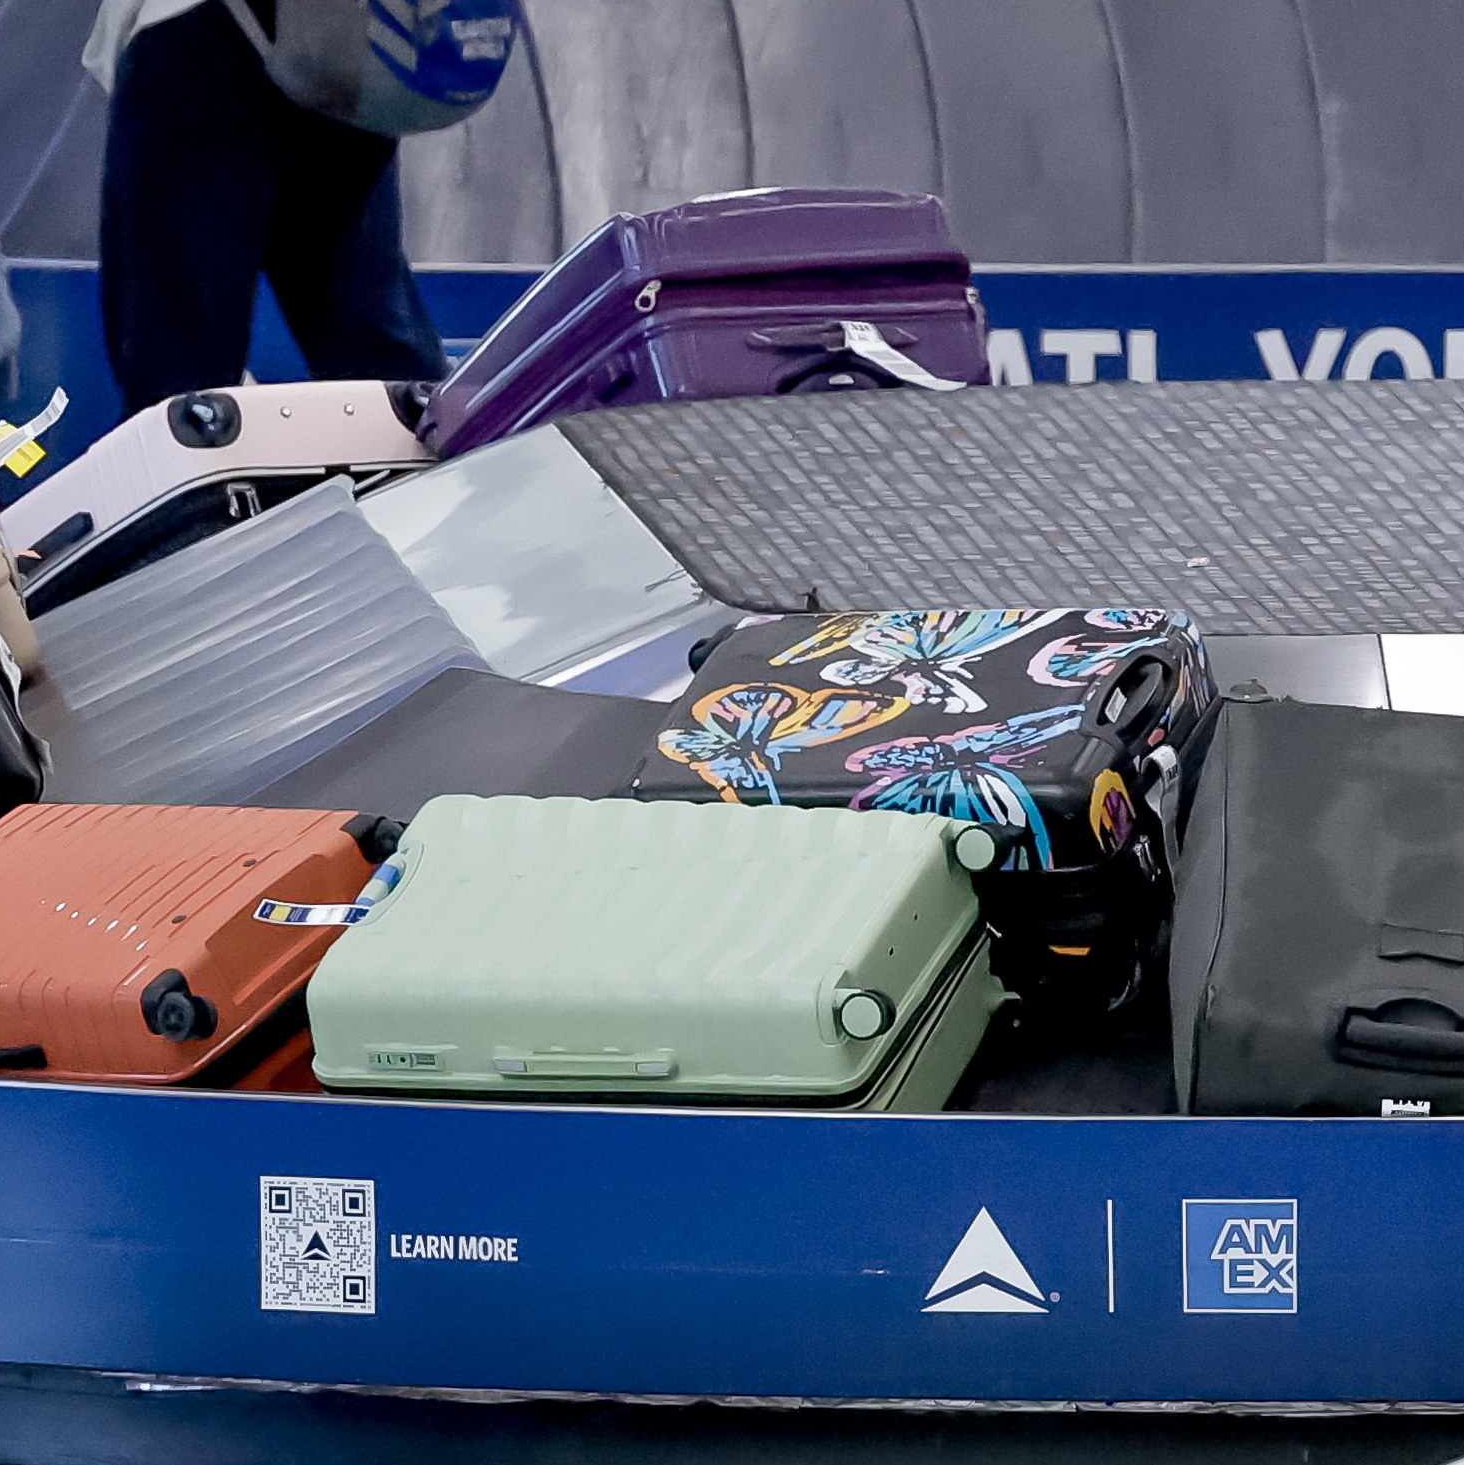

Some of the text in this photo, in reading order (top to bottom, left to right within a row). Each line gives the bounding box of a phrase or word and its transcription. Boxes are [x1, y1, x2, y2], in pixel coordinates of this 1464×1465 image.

[390, 1234, 519, 1262] LEARN MORE
[1213, 1220, 1296, 1256] AM
[1225, 1257, 1296, 1292] EX
